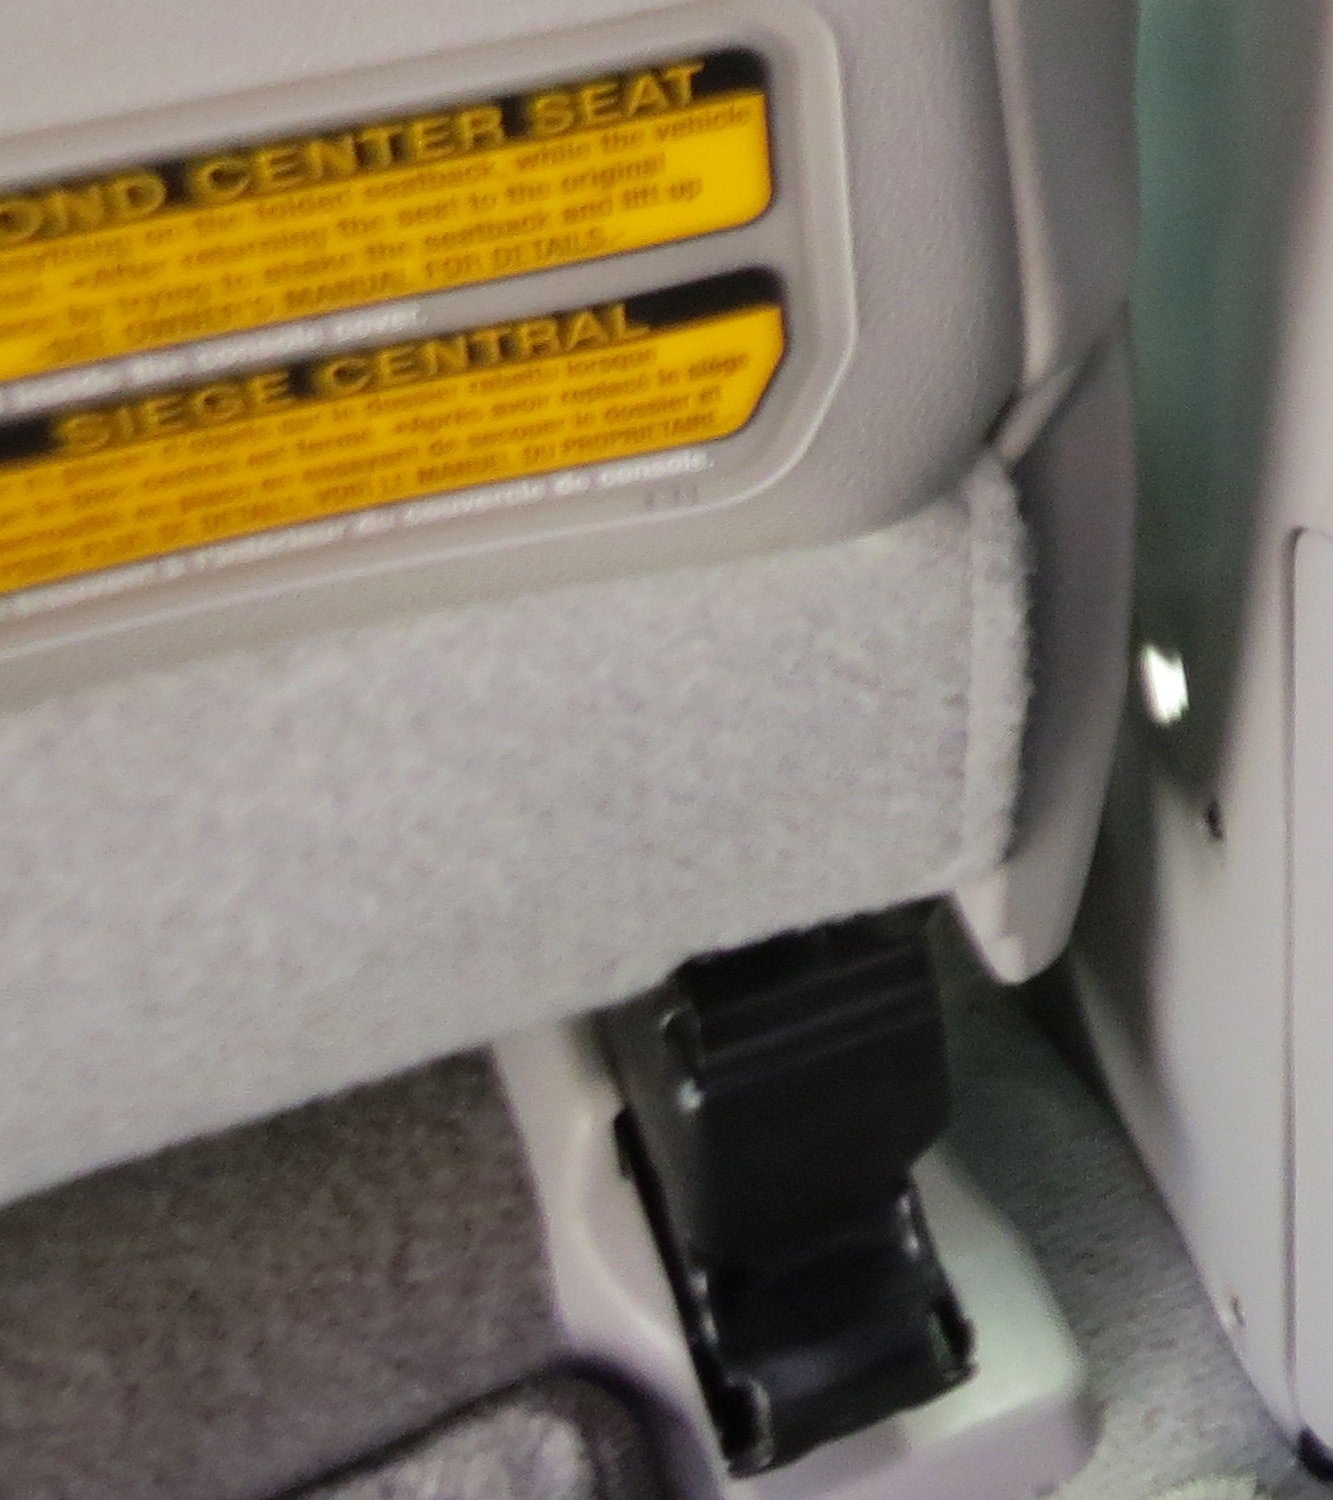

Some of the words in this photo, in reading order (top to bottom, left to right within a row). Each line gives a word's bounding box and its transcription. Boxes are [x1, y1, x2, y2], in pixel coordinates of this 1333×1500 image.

[195, 103, 504, 201] CENTER
[531, 61, 705, 132] SEAT
[322, 298, 651, 397] CENTRAL
